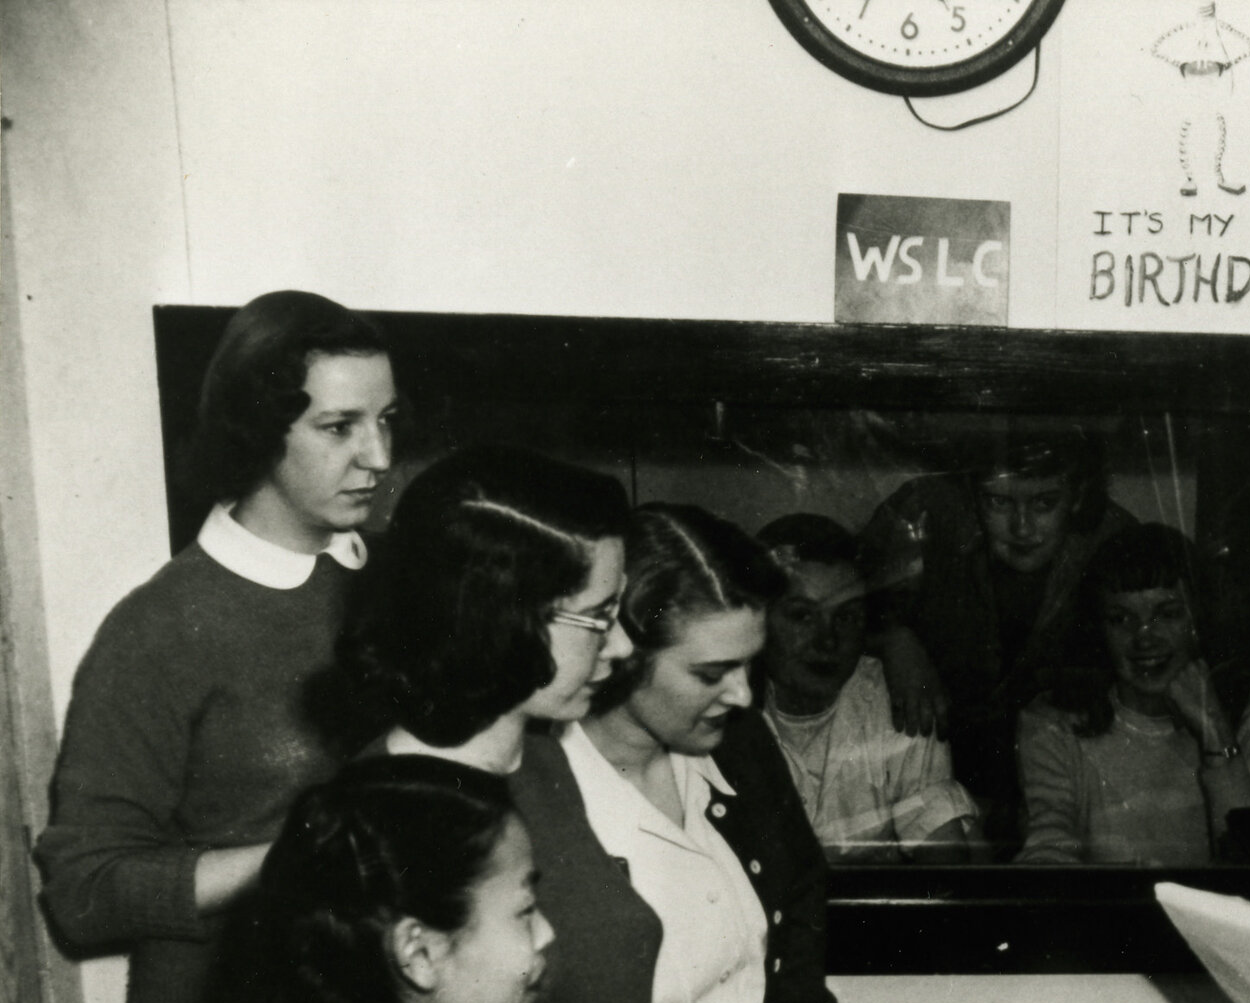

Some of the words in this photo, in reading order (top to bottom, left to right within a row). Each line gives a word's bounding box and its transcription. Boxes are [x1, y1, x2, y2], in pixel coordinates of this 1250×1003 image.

[900, 12, 919, 40] 6
[950, 6, 966, 32] 5
[1093, 210, 1164, 236] IT'S
[1190, 212, 1234, 237] MY
[846, 232, 1002, 286] WSLC
